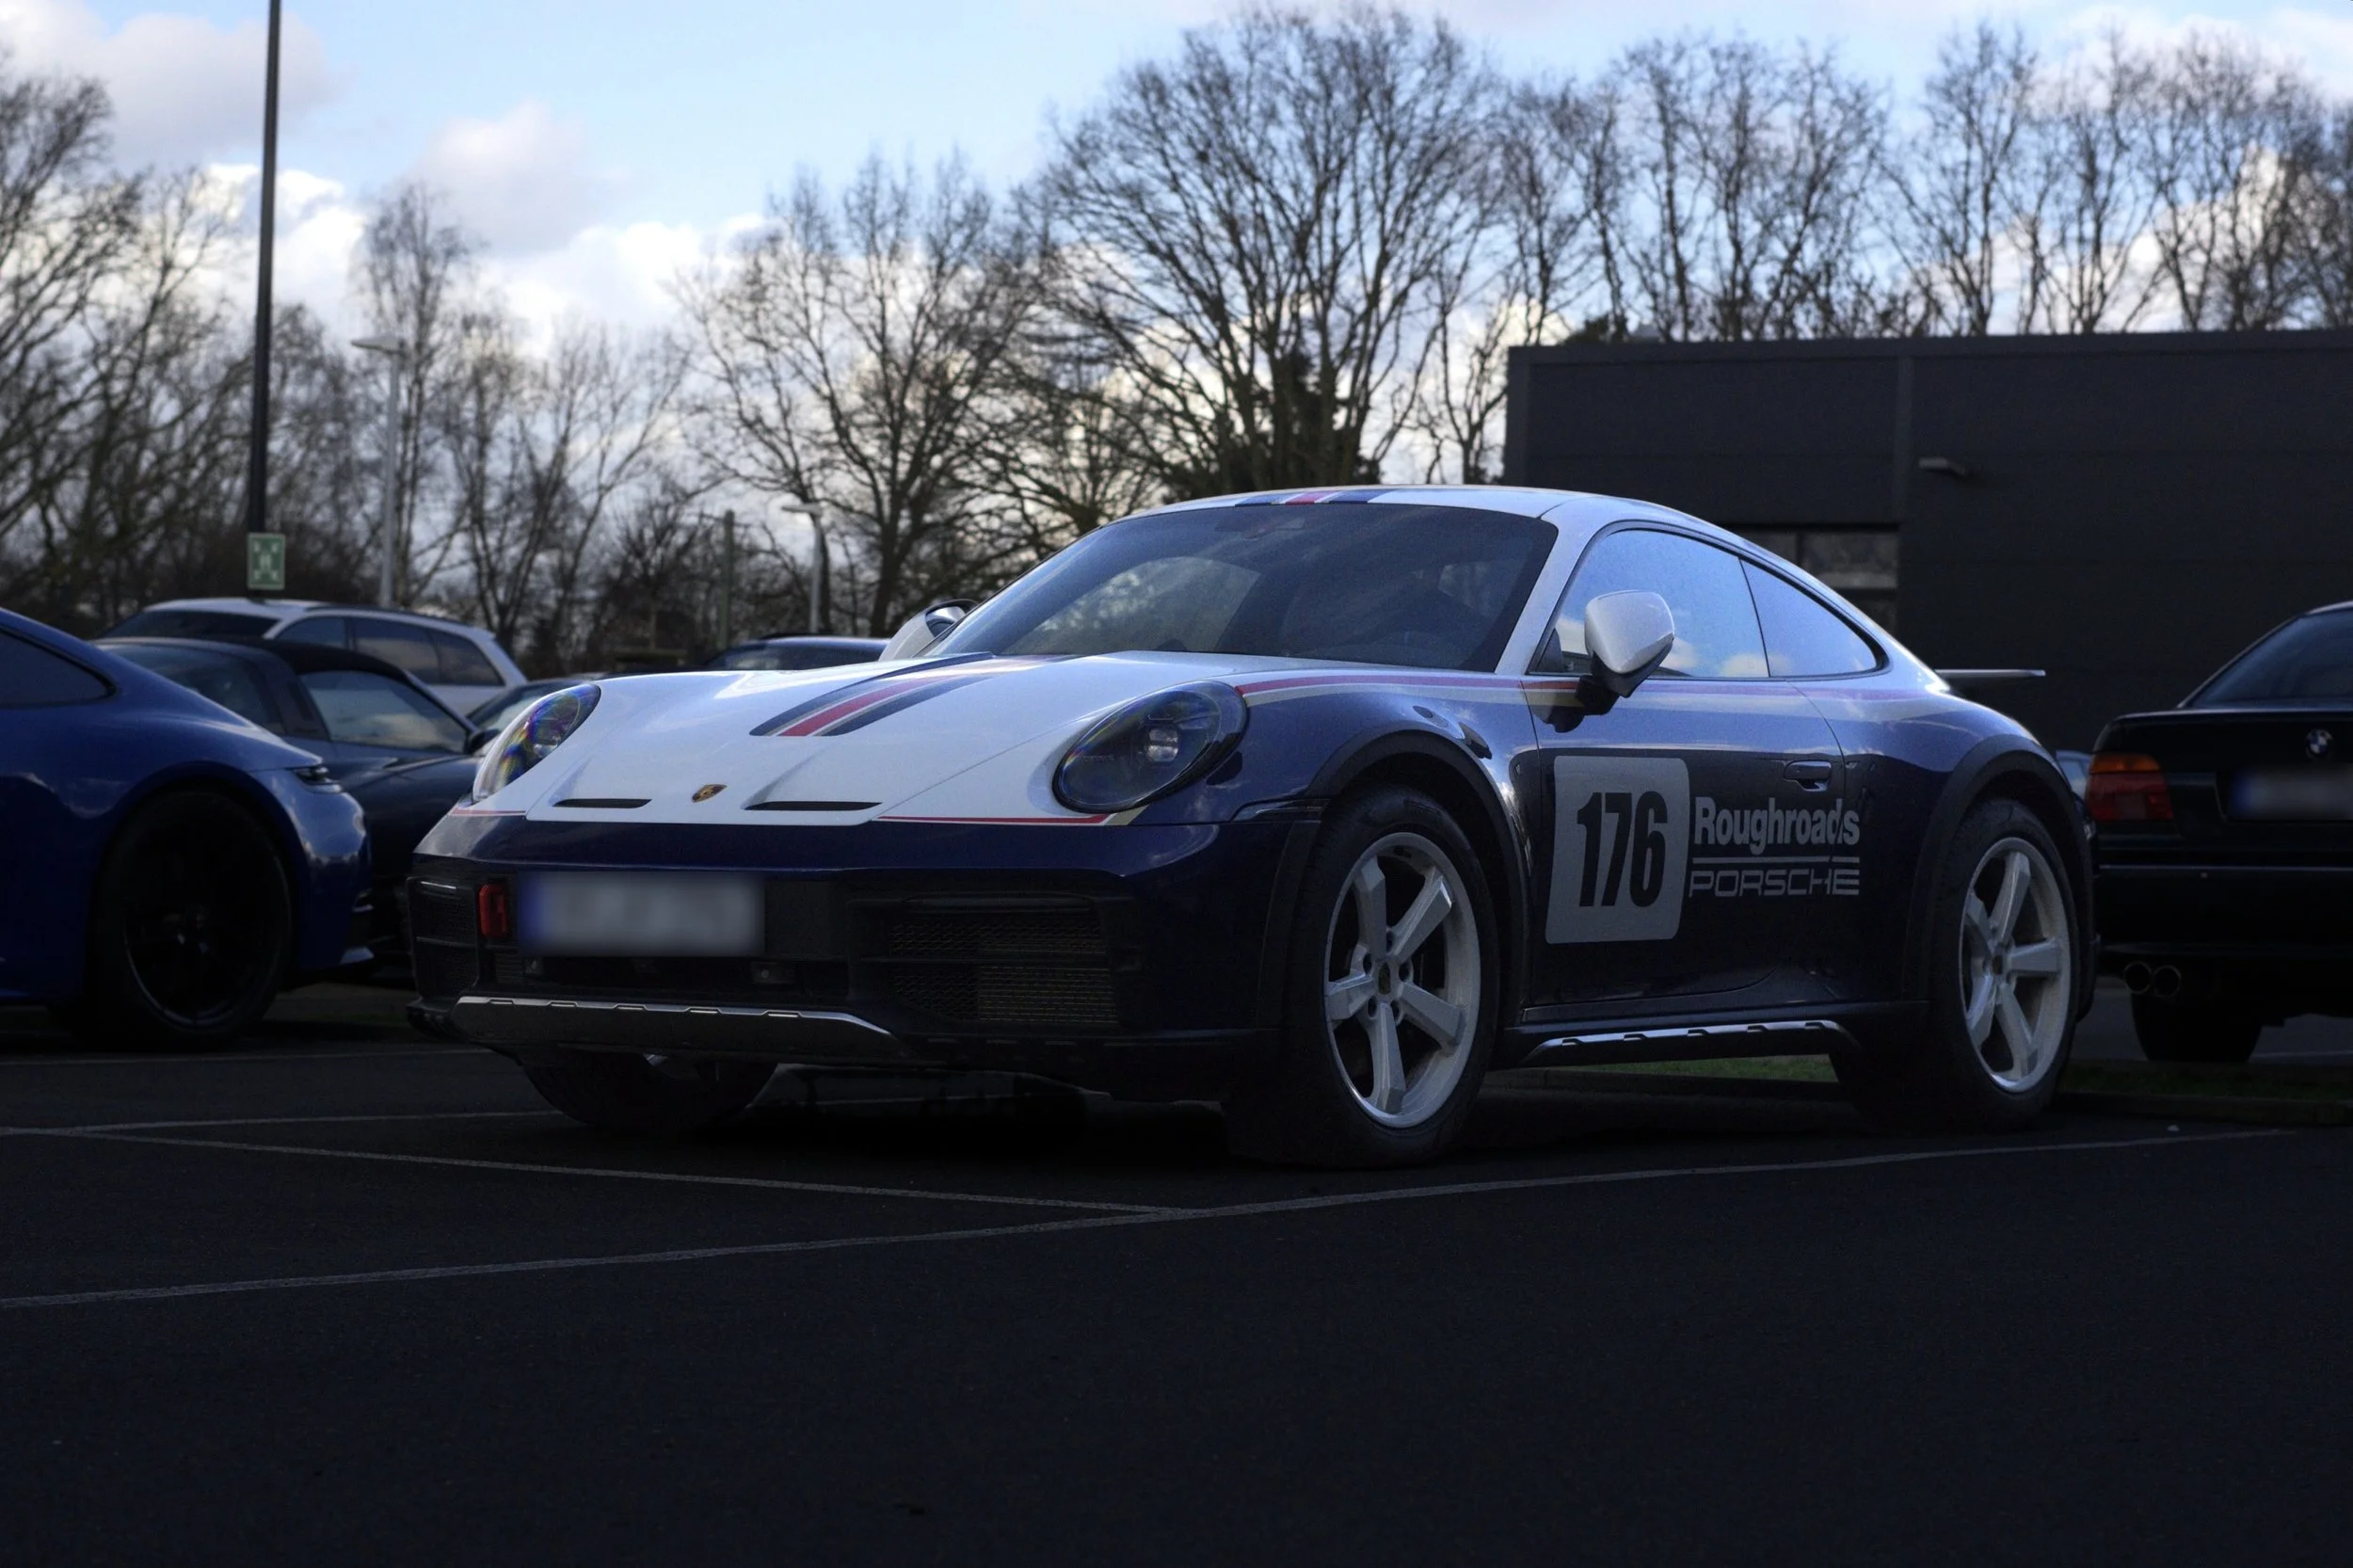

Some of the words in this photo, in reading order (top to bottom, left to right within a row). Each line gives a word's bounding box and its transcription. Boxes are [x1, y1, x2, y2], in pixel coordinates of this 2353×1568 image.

[1577, 792, 1667, 906] 176
[1694, 797, 1860, 855] Roughroads
[1689, 869, 1860, 897] PORSCHE
